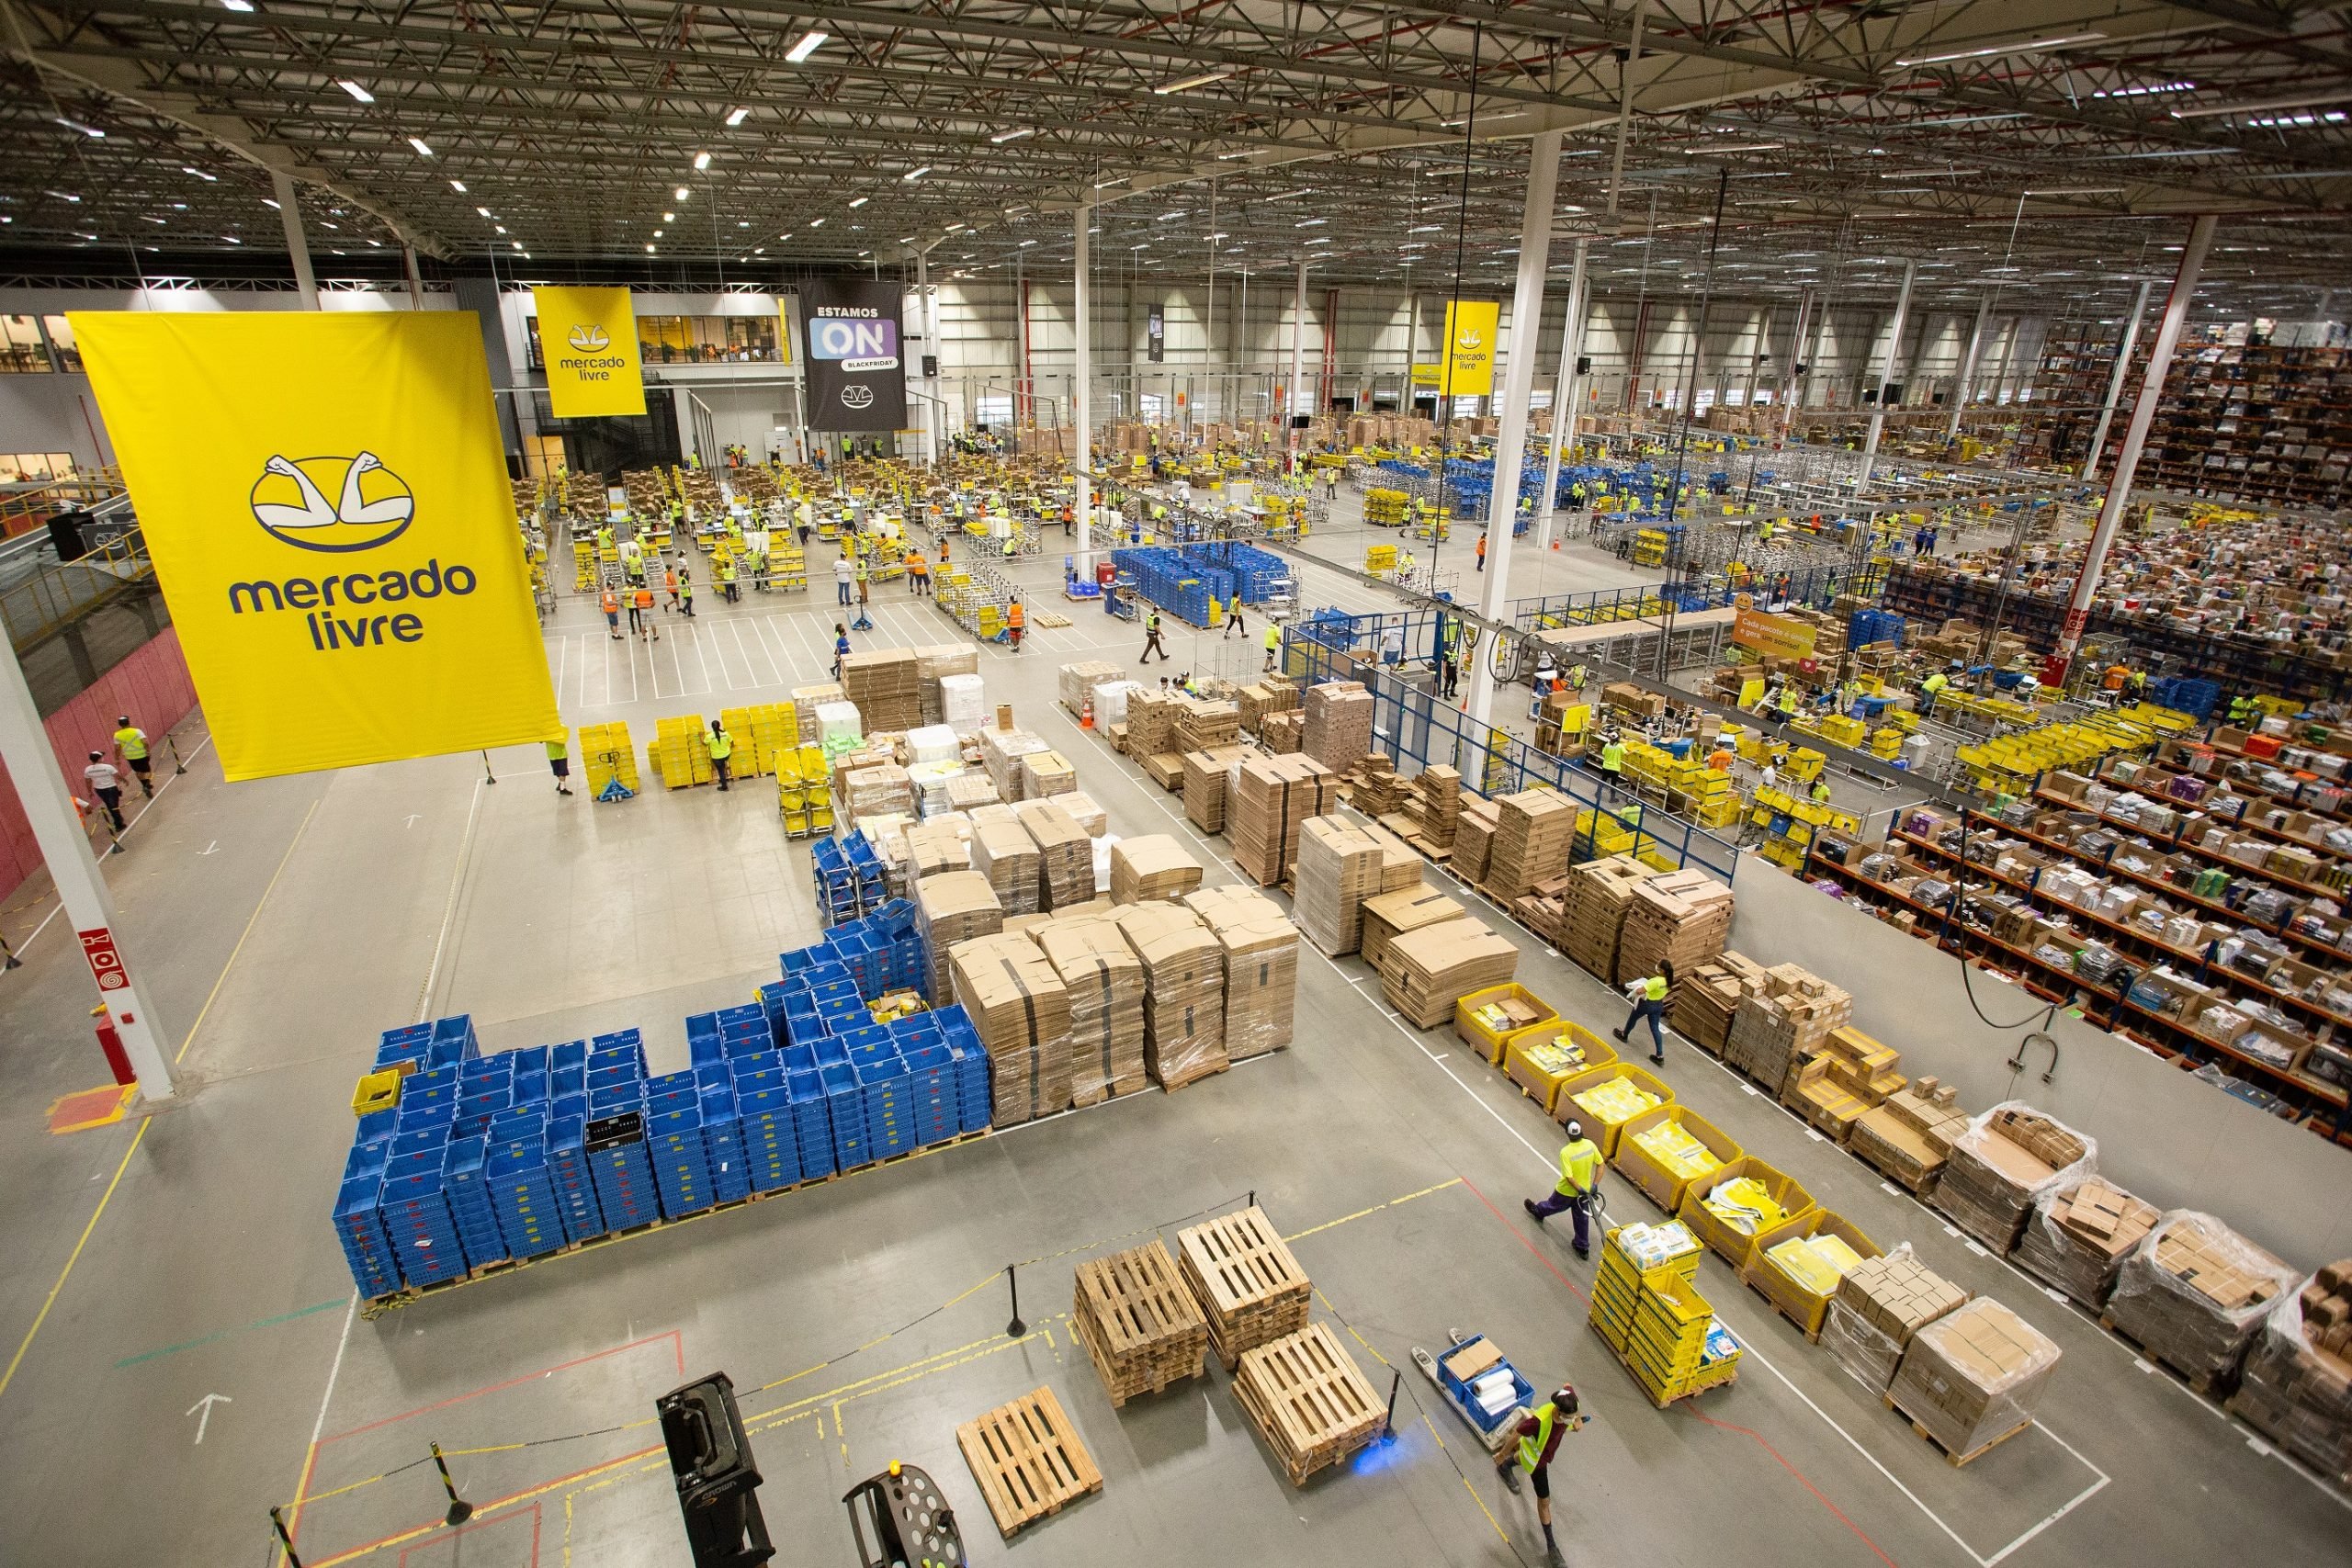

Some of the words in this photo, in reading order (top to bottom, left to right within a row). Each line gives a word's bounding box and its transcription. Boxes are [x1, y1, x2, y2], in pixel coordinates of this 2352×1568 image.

[817, 307, 878, 318] ESTAMOS
[821, 322, 884, 355] ON
[560, 355, 626, 368] mercado
[1452, 352, 1487, 361] mercado
[847, 359, 893, 368] BLACKFRIDAY
[1459, 361, 1476, 369] livre
[579, 369, 610, 381] livre
[229, 558, 477, 615] mercado
[306, 611, 424, 651] livre
[1742, 617, 1759, 628] Cada
[1759, 625, 1783, 637] pacote
[1746, 629, 1761, 638] gera
[1773, 638, 1800, 650] sorriso!
